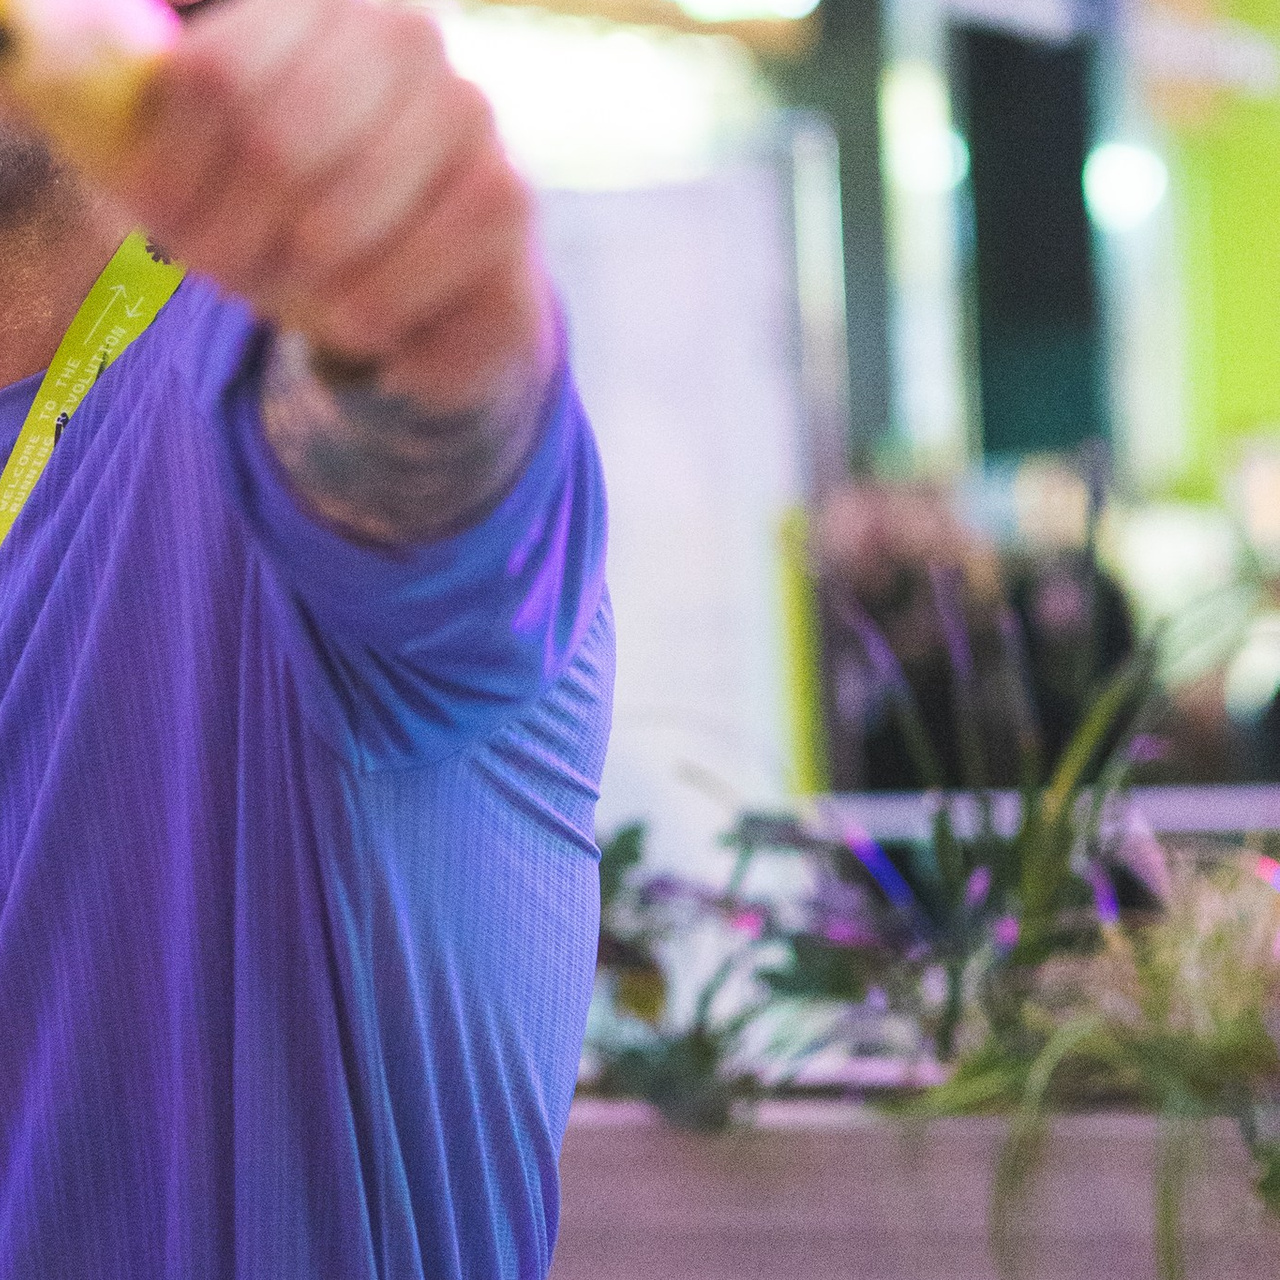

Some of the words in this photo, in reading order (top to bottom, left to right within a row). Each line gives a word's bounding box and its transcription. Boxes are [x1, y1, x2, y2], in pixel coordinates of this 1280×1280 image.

[40, 400, 56, 420] TO
[56, 358, 81, 389] THE
[11, 436, 54, 513] RUNNING
